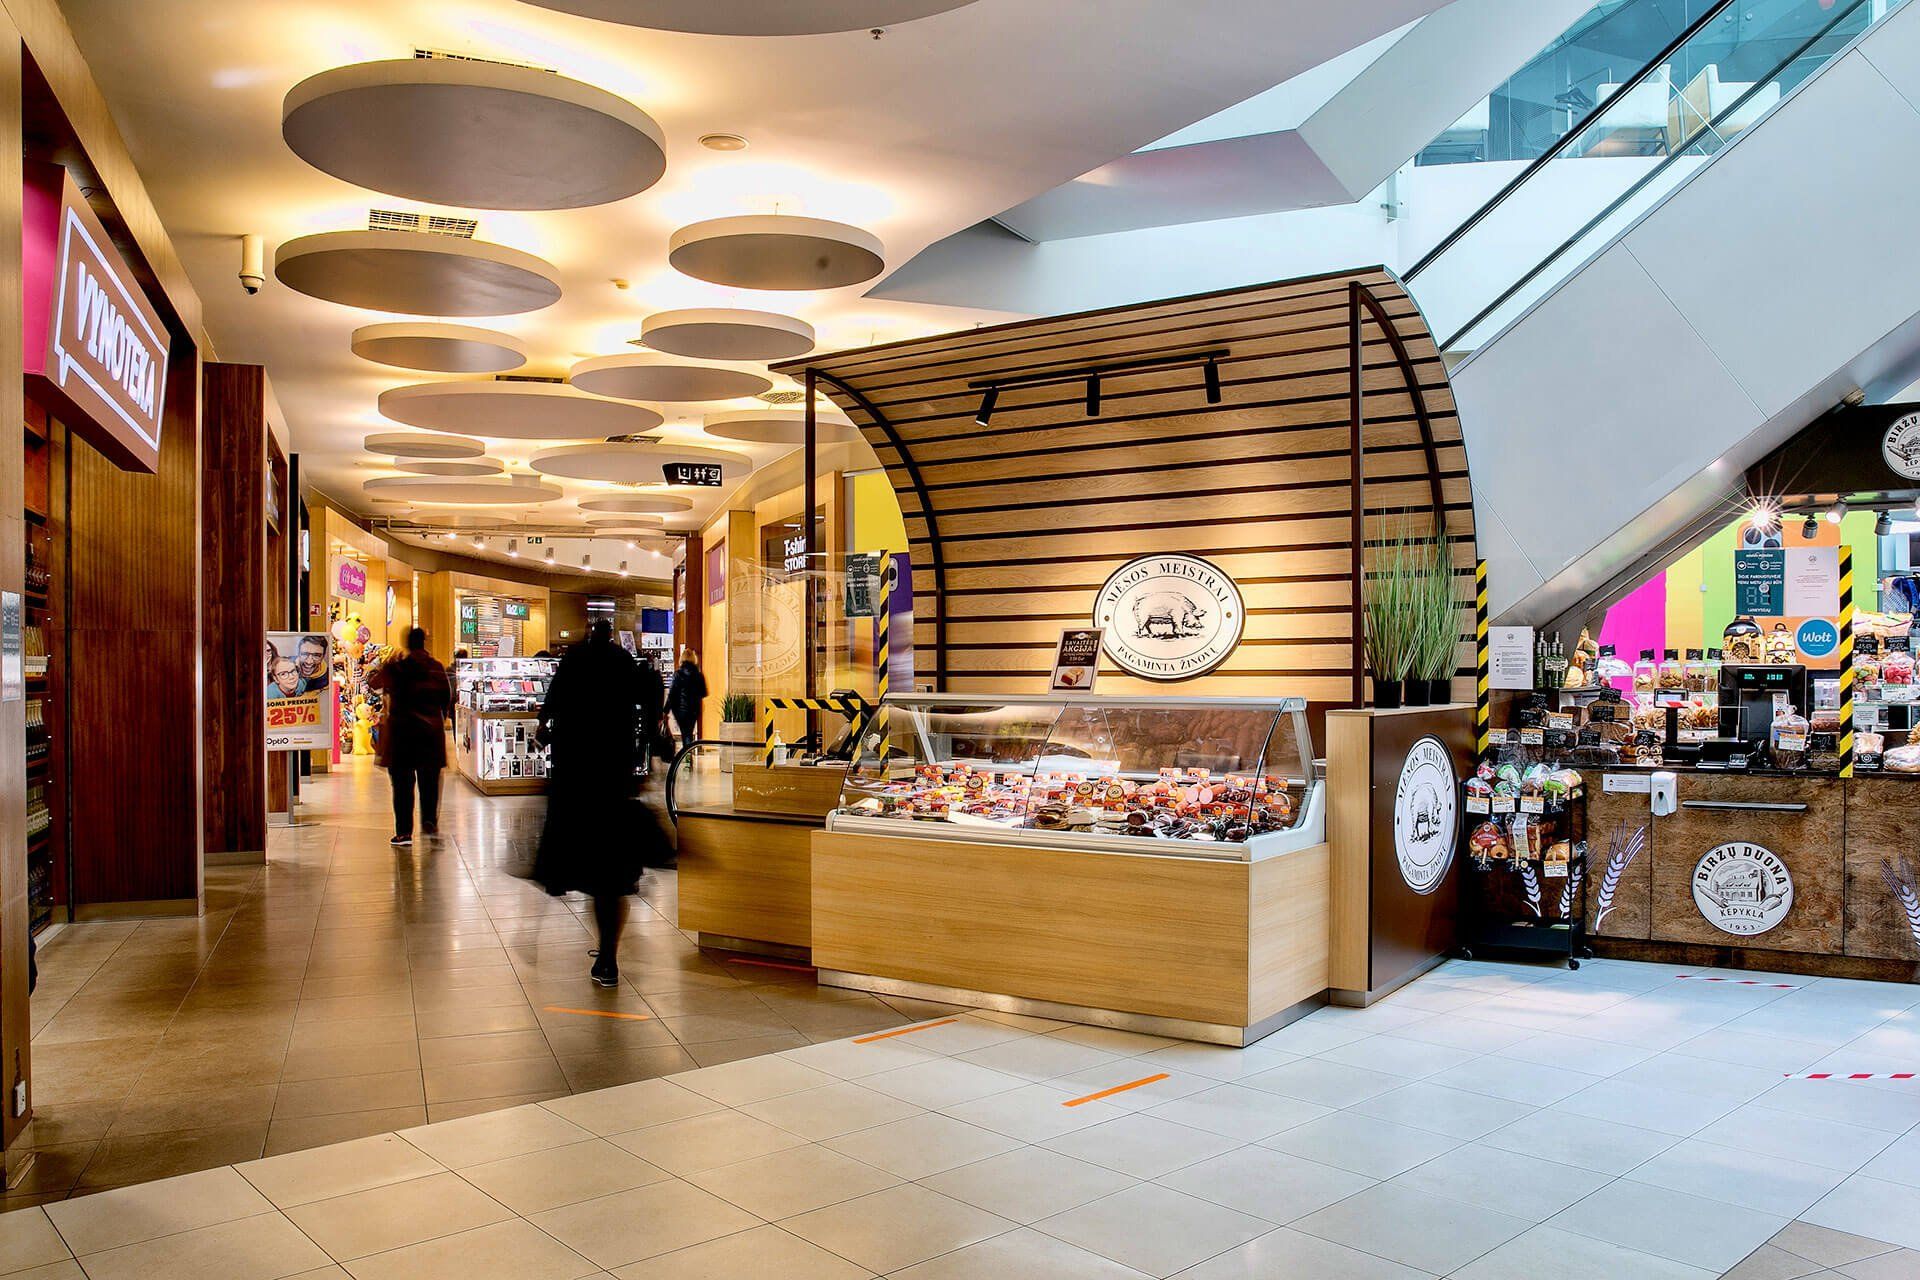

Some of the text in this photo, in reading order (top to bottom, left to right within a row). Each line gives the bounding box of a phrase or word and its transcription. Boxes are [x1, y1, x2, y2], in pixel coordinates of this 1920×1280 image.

[78, 261, 155, 420] VYNOTEKA
[1107, 562, 1229, 602] MĖSOS MEISTRAI
[1802, 631, 1833, 644] Wolt
[1117, 645, 1176, 672] PAGAMINTA
[1697, 846, 1787, 885] BIRŽŲ DUONA
[1720, 908, 1764, 919] KEPYKLA
[1729, 923, 1756, 931] 1953
